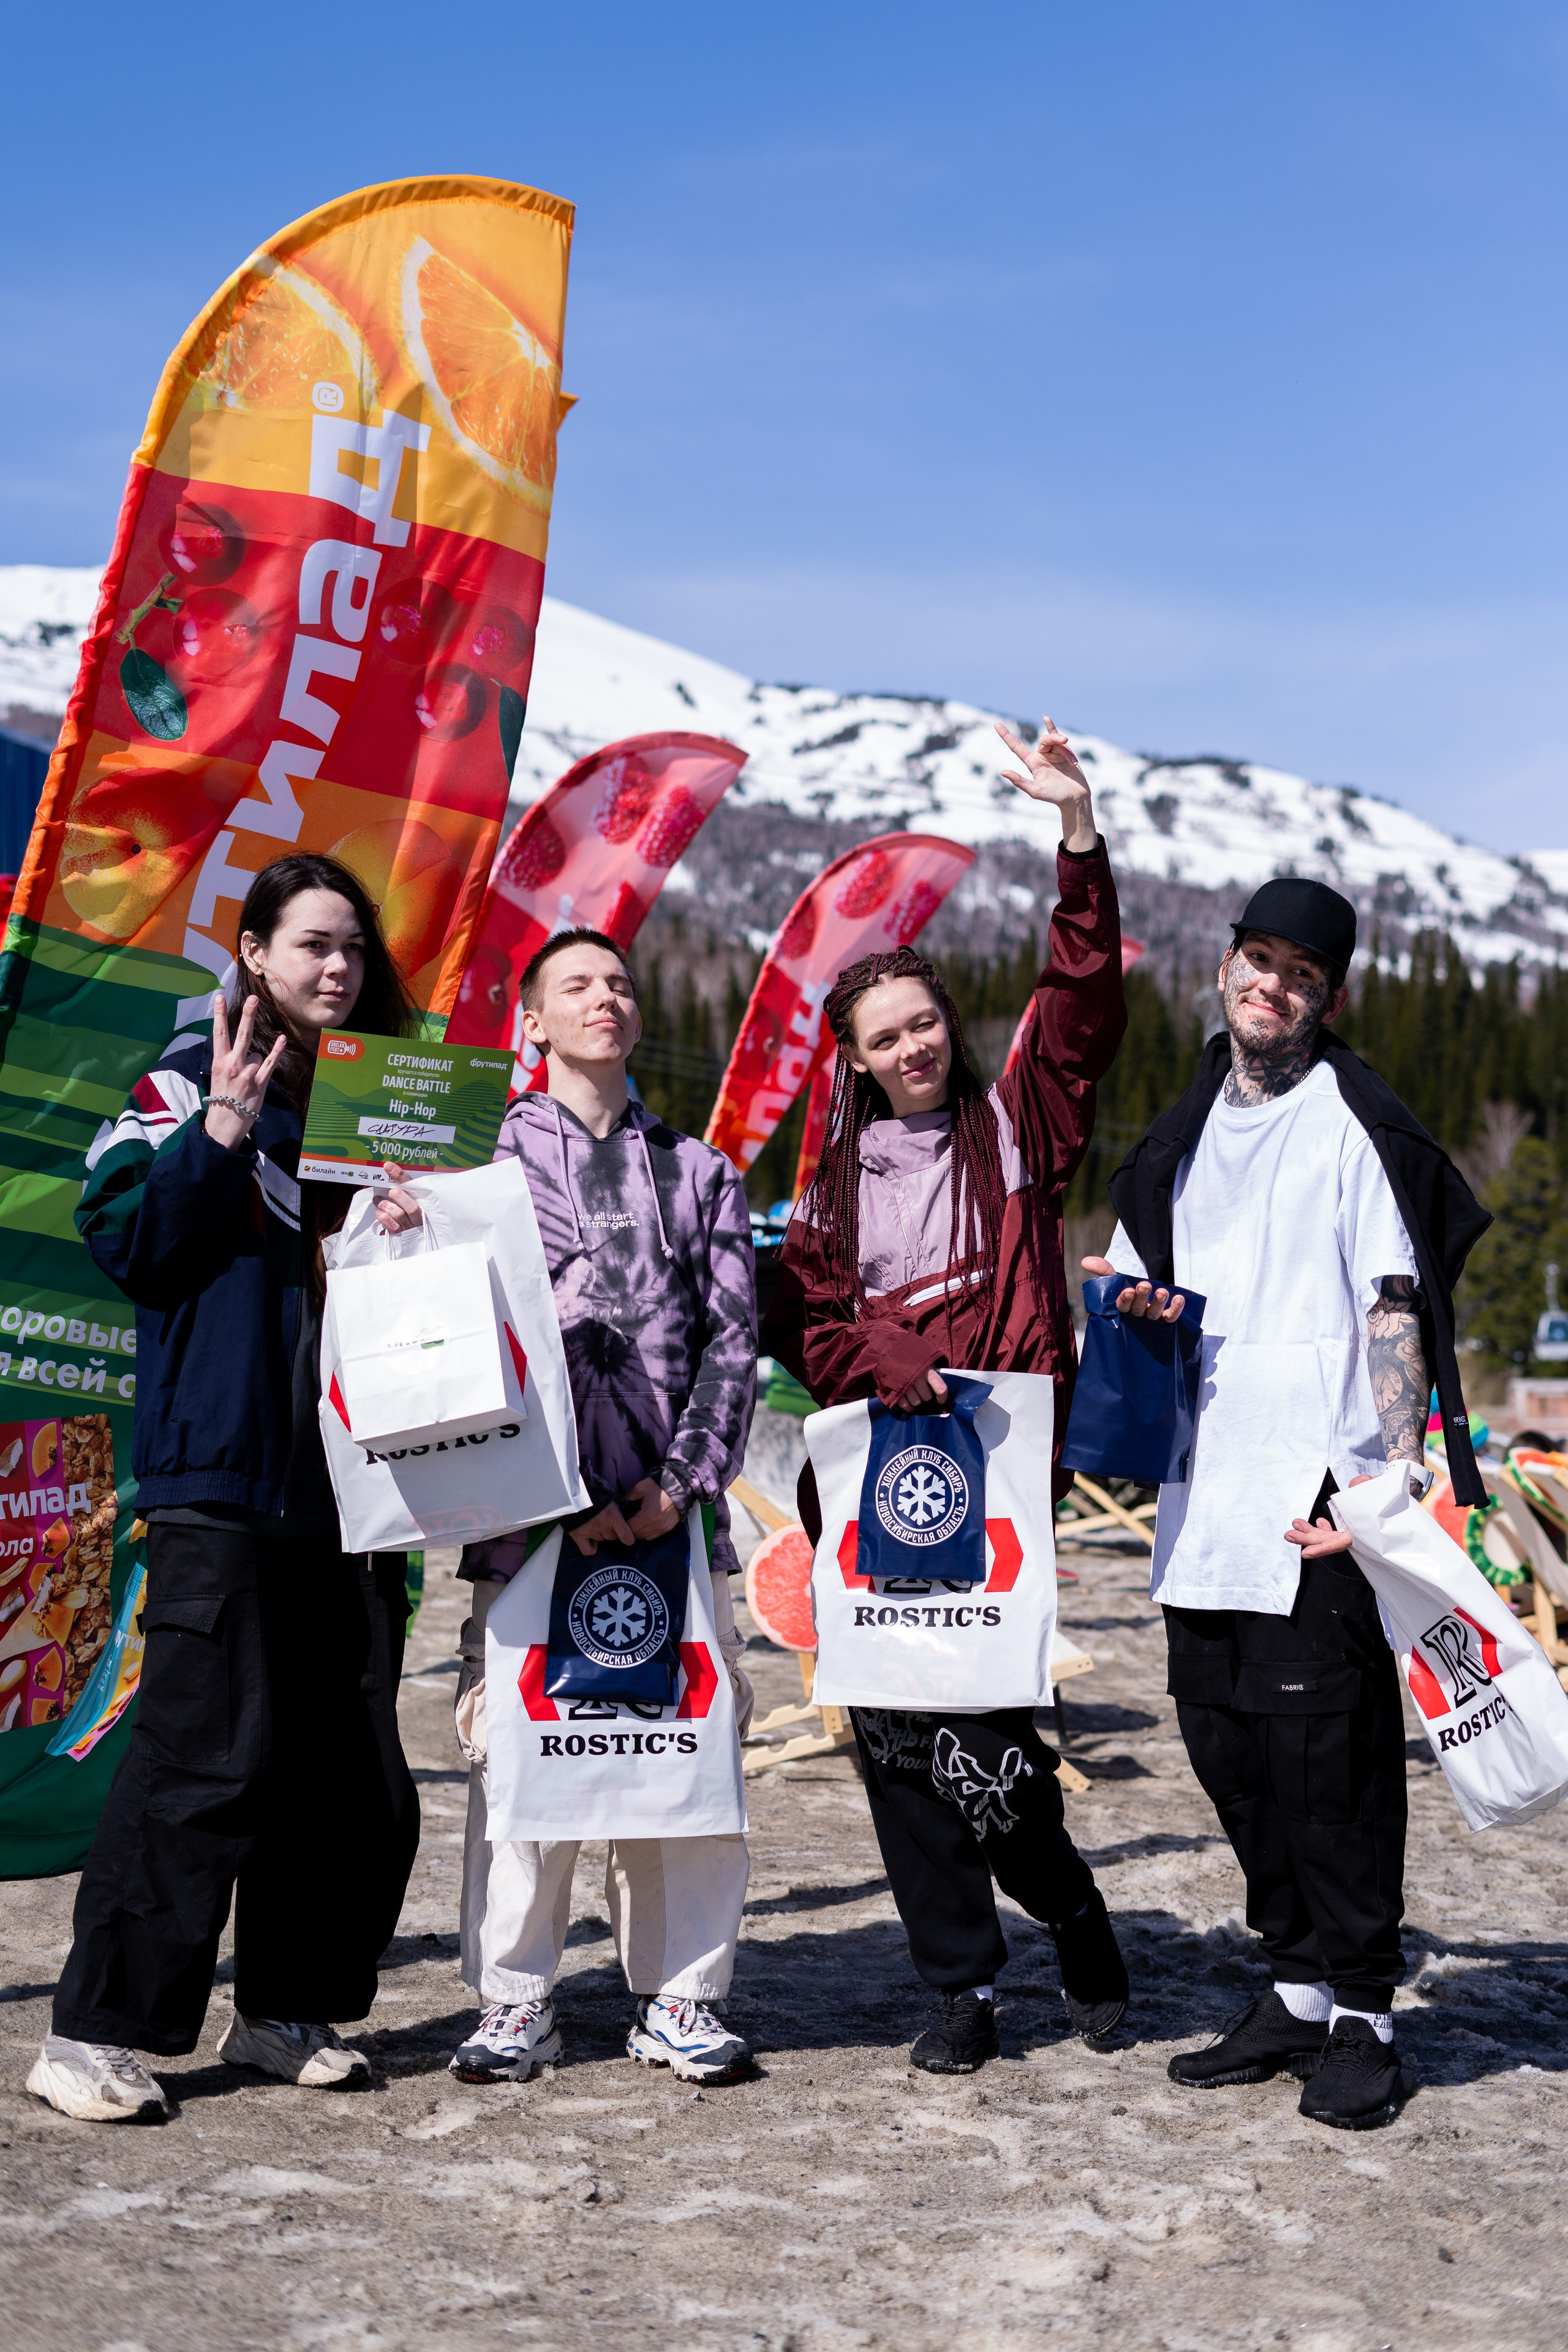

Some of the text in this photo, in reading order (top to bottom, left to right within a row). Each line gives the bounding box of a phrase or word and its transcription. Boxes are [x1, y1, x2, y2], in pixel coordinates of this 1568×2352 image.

[387, 1054, 454, 1072] СЕРТИФИКАТ
[382, 1075, 451, 1094] DANCE BATTLE
[389, 1099, 437, 1121] Hip-Hop
[402, 1145, 439, 1161] рублей
[312, 1166, 336, 1175] билайн
[594, 1212, 605, 1221] all
[606, 1212, 634, 1221] start
[18, 1356, 107, 1393] всей
[881, 1448, 963, 1493] ХОККЕЙНЫЙ КЛУБ СИБИРЬ
[878, 1500, 965, 1543] НОВОСИБИРСКАЯ ОБЛАСТЬ
[575, 1568, 664, 1616] ХОККЕЙНЫЙ КЛУБ СИБИРЬ
[854, 1605, 1002, 1628] ROSTIC'S
[571, 1621, 665, 1665] НОВОСИБИРСКАЯ ОБЛАСТЬ
[540, 1732, 698, 1757] ROSTIC'S
